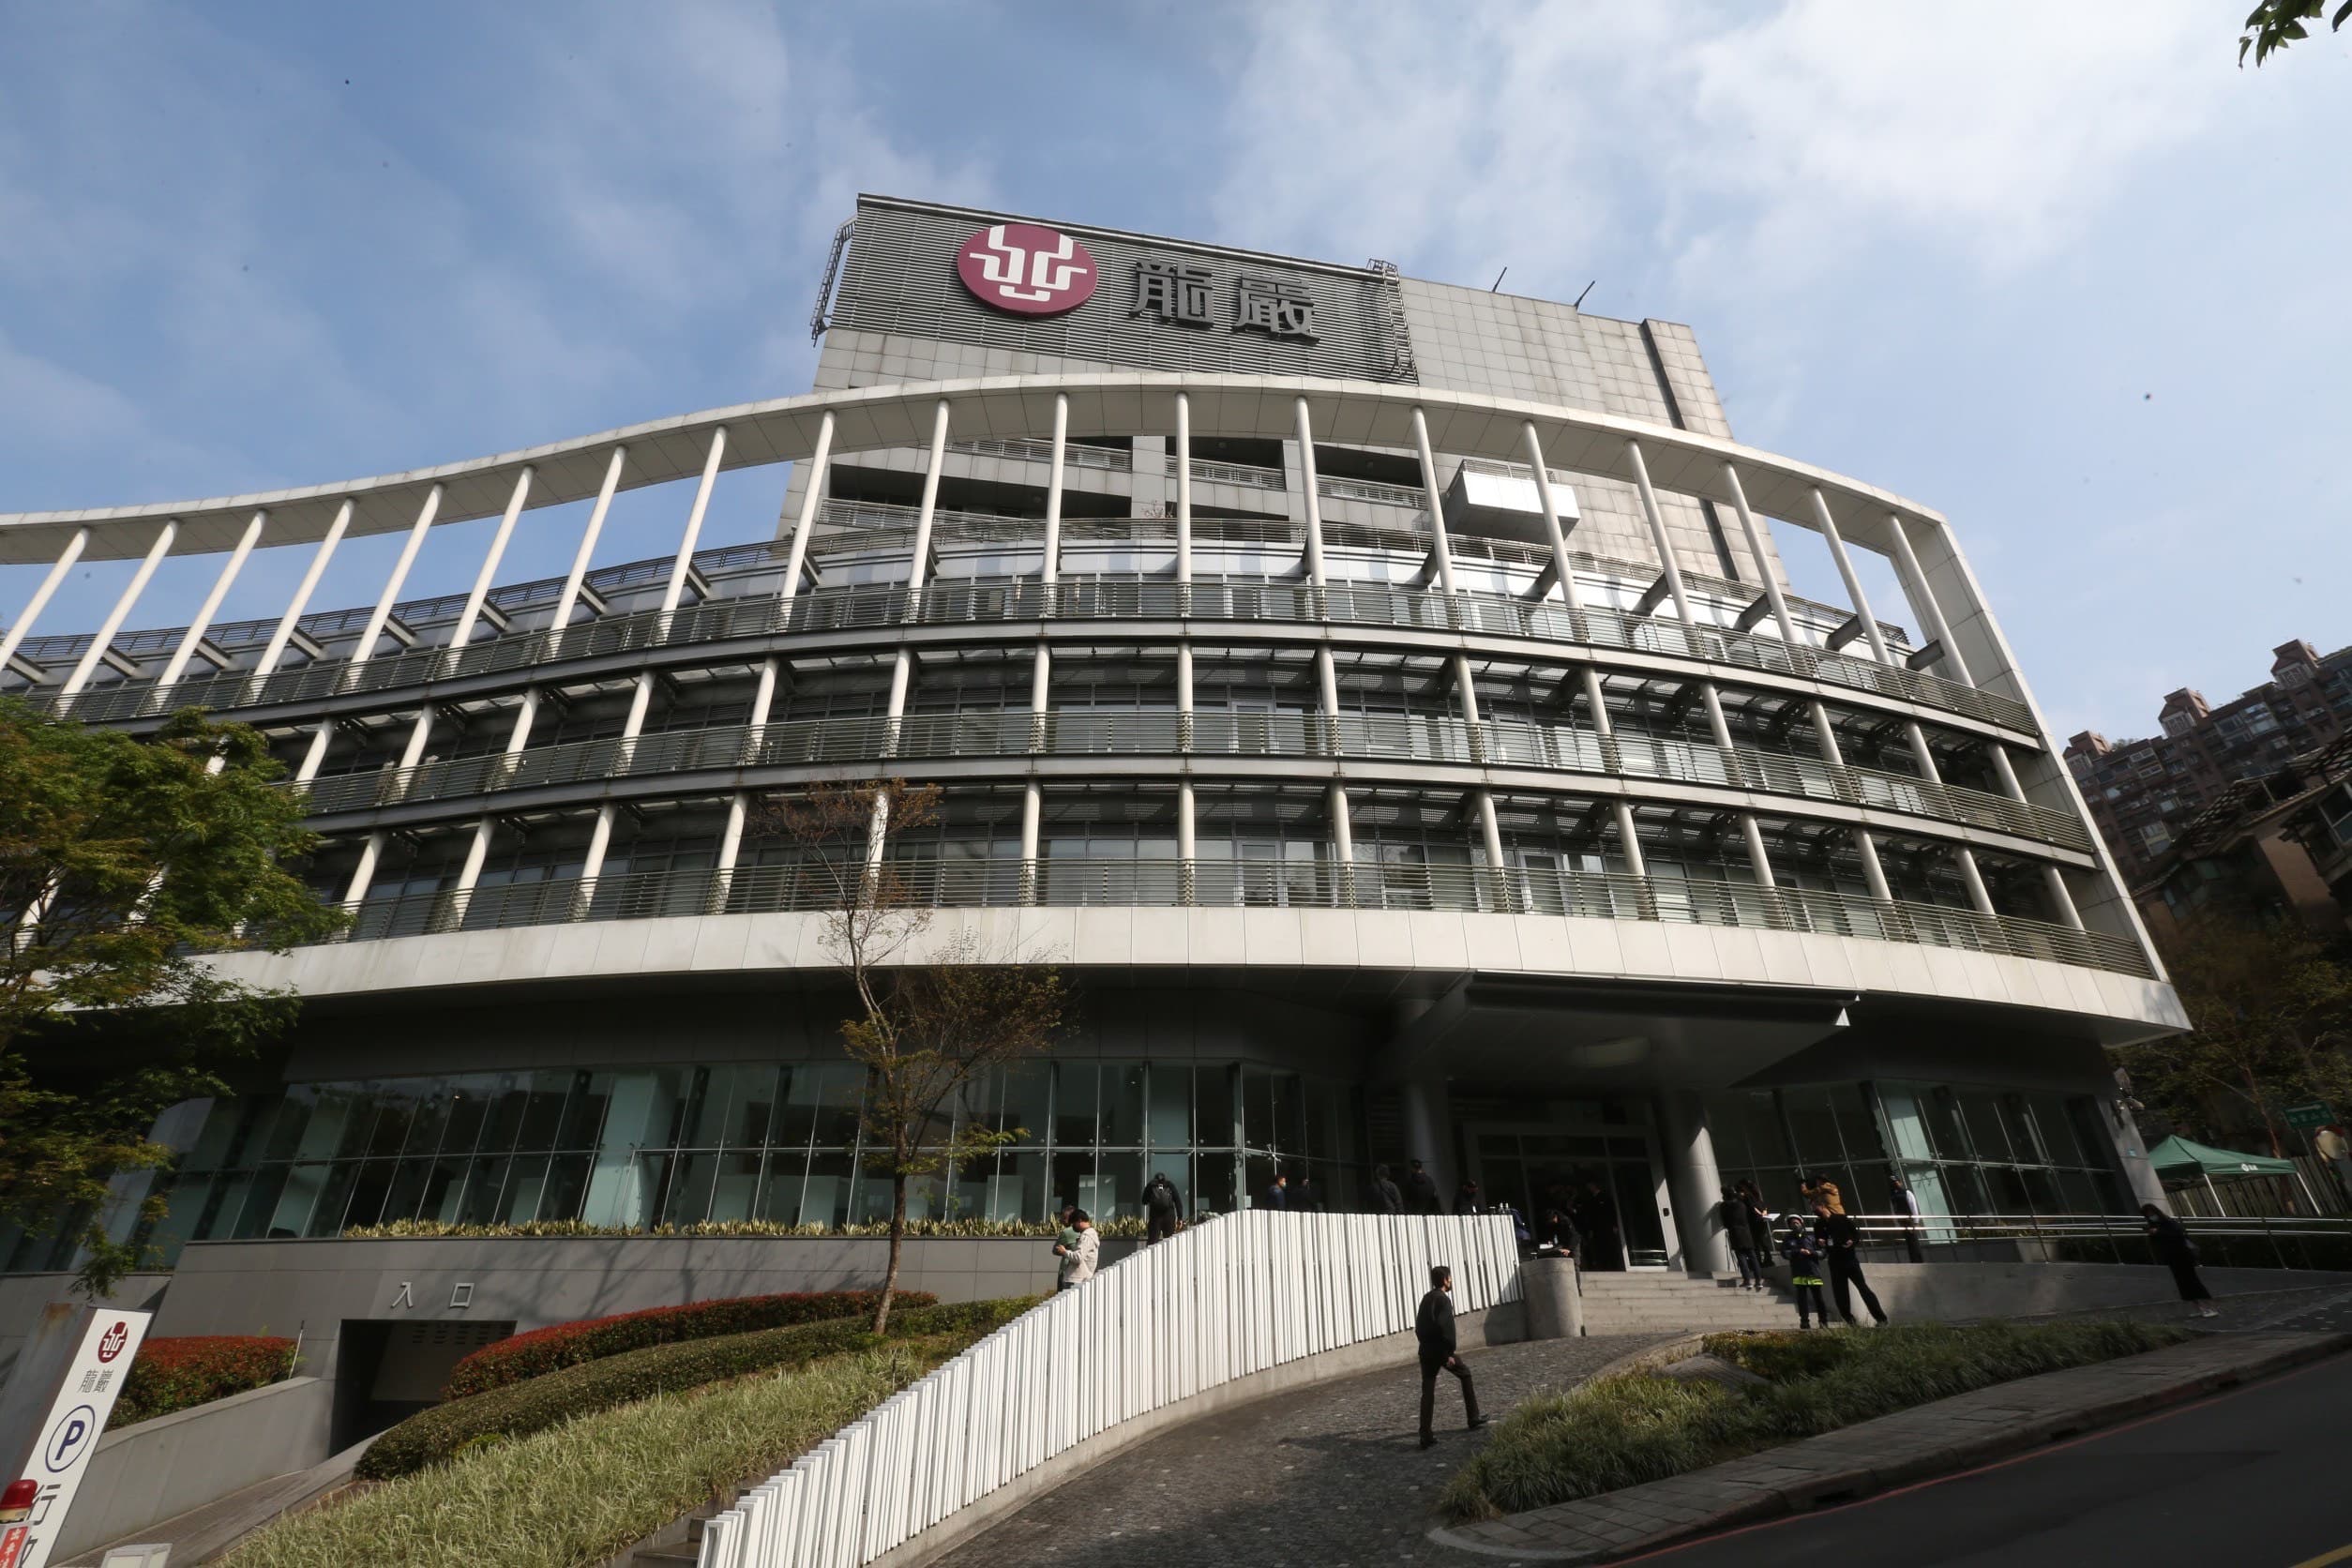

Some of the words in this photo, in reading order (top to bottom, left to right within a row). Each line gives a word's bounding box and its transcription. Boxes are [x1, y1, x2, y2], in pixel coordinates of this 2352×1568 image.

[1128, 257, 1317, 339] 龍巖
[390, 1281, 475, 1307] 入口
[54, 1419, 85, 1461] P
